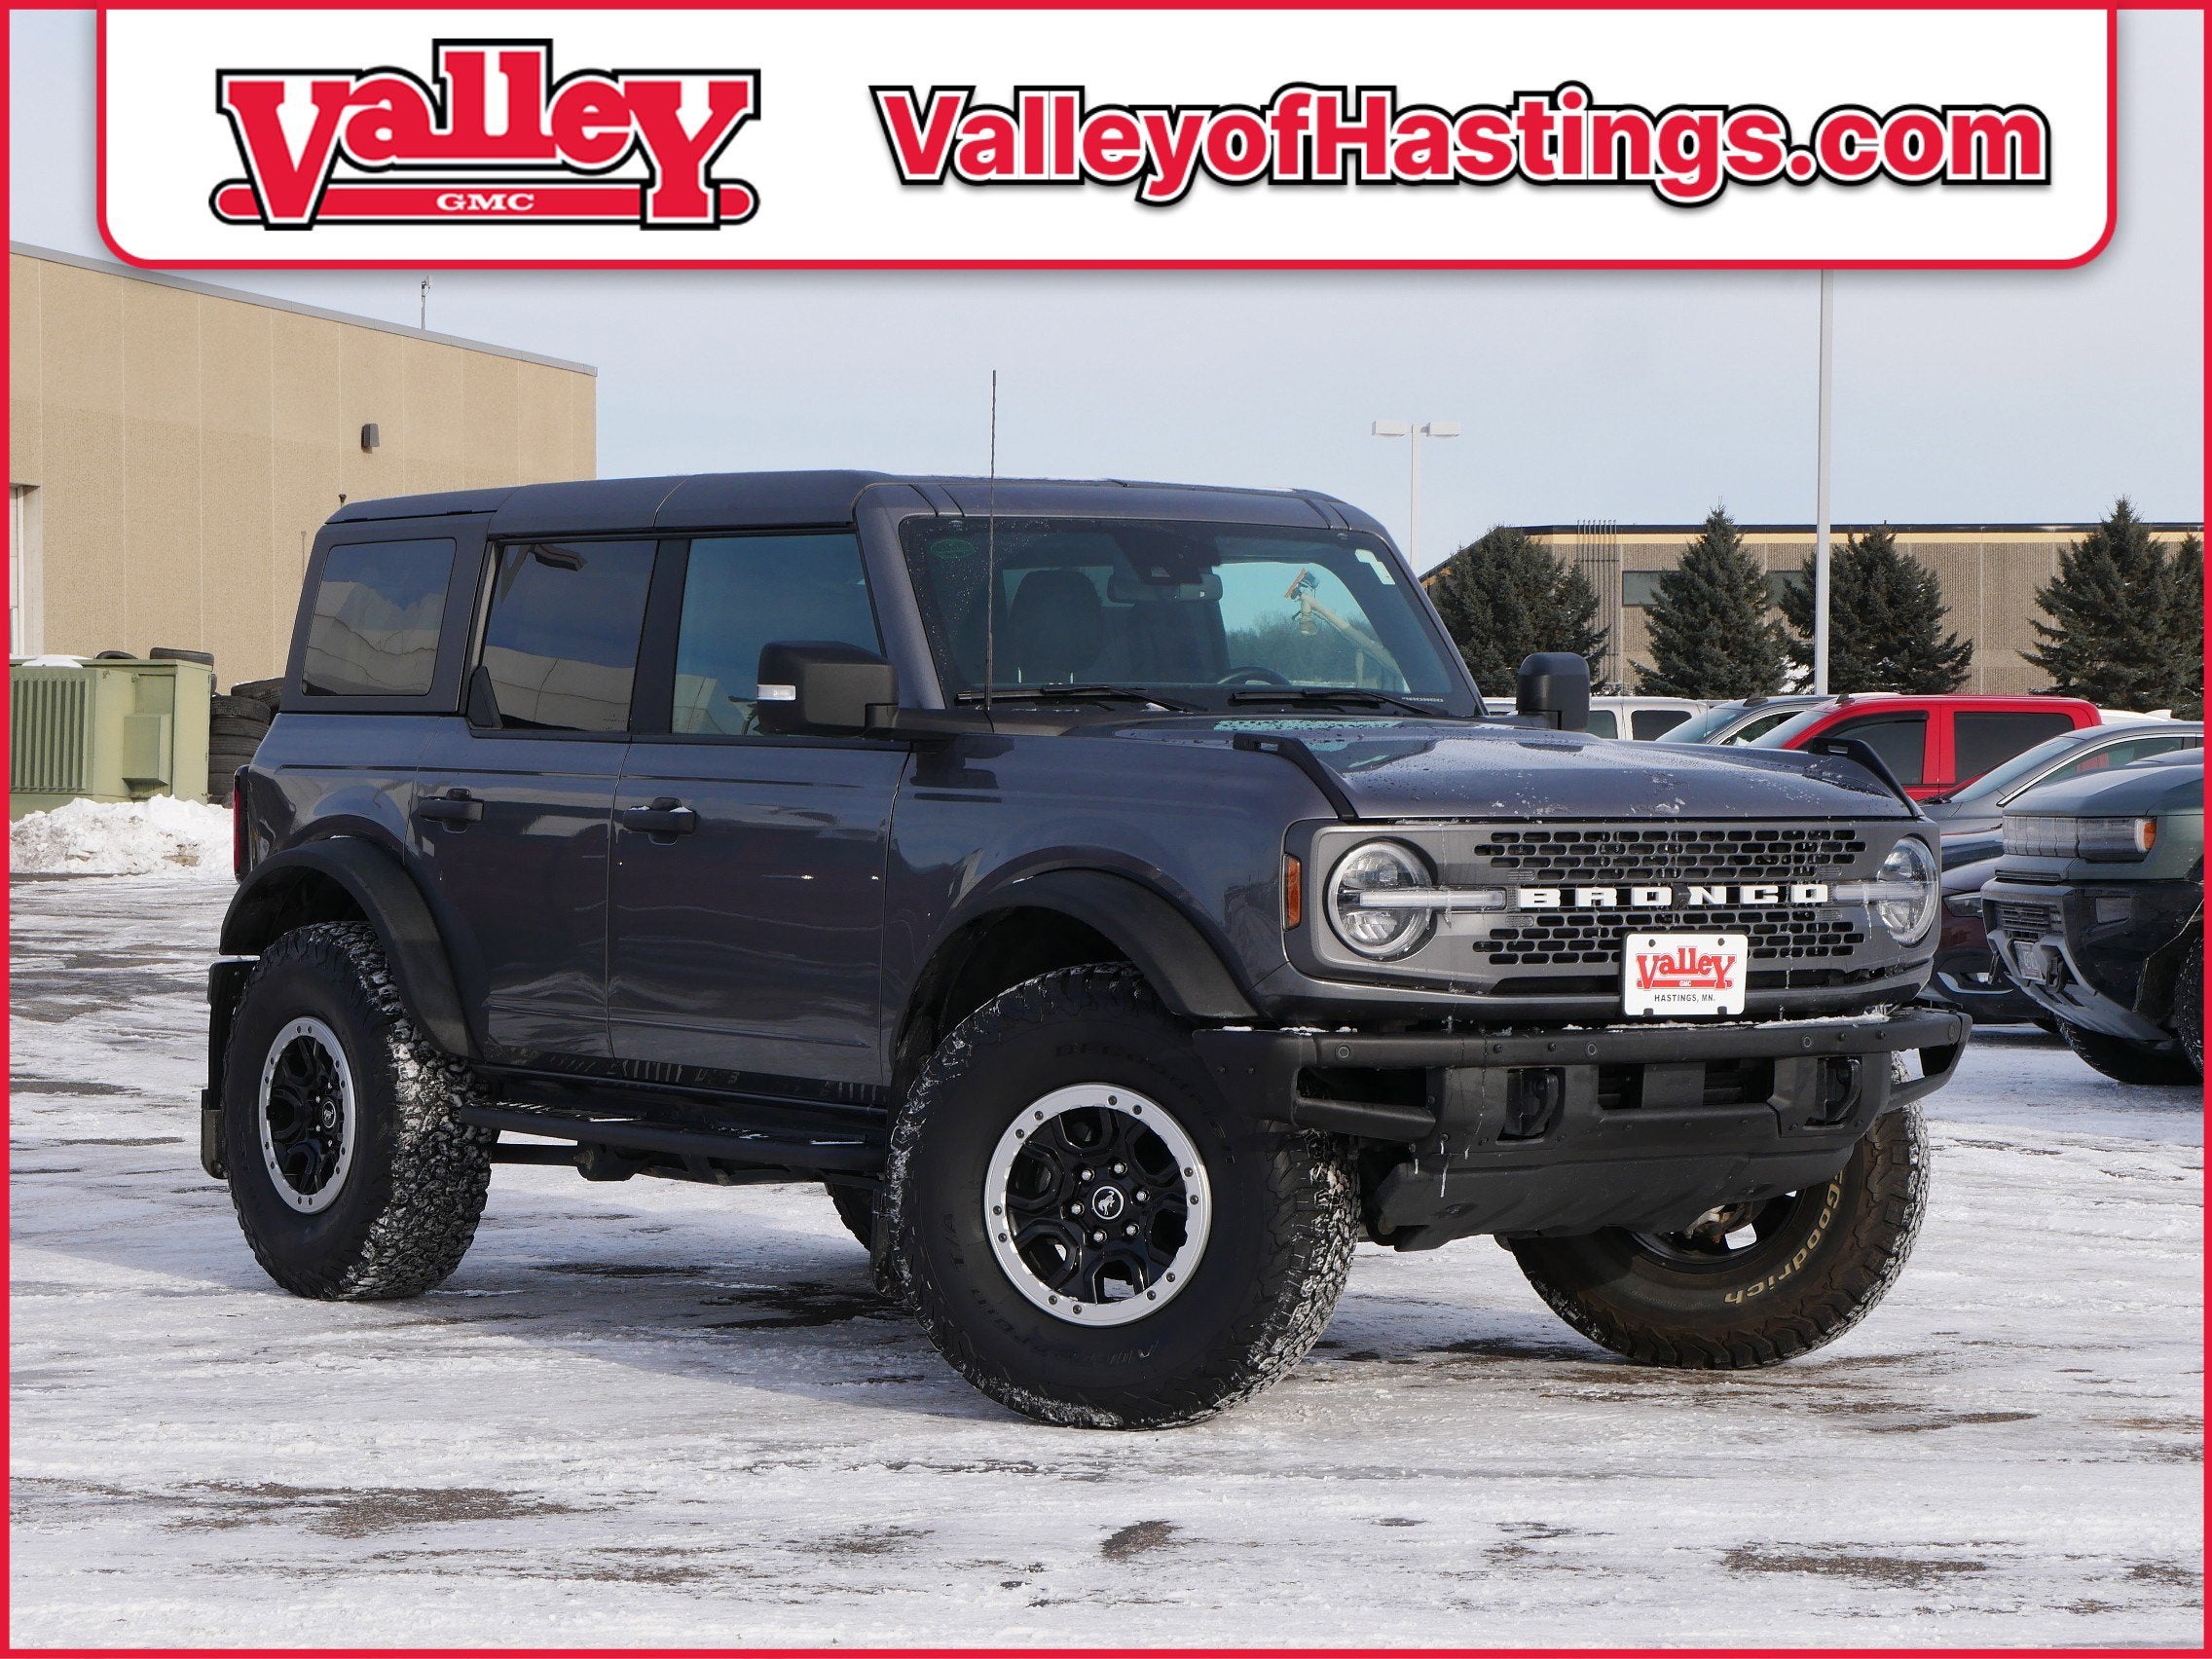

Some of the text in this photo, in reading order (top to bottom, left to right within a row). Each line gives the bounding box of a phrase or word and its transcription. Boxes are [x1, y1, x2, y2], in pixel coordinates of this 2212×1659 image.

[1517, 883, 1828, 908] BRONCO
[1654, 993, 1715, 1004] HASTINGS, MN.
